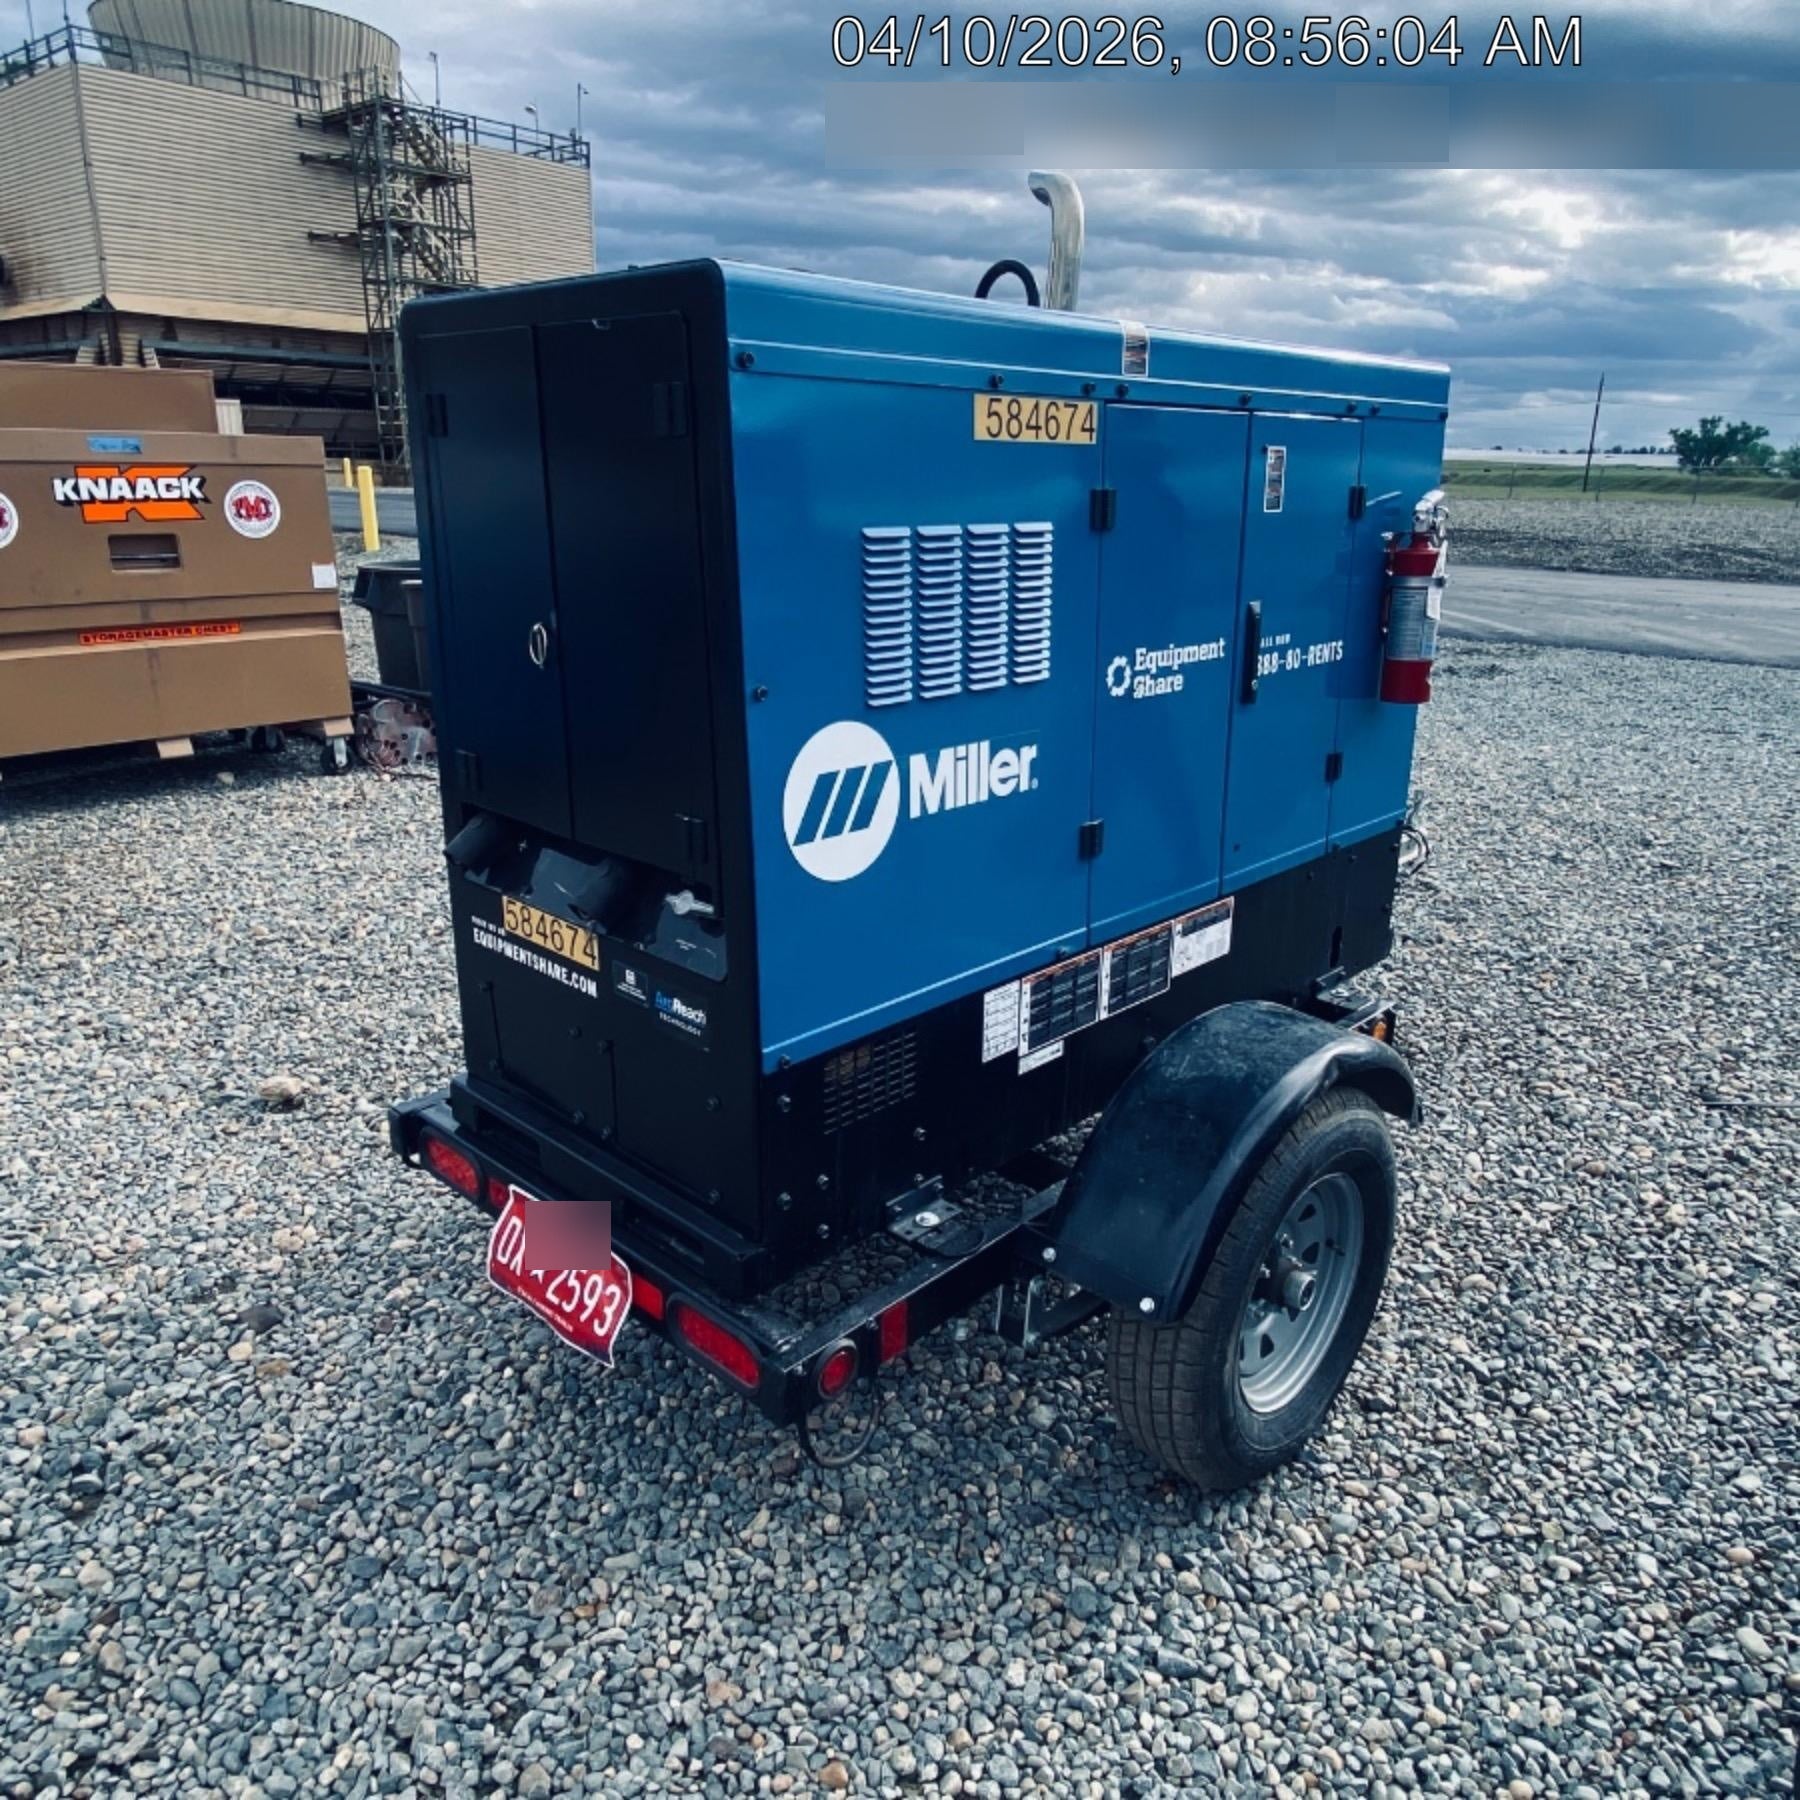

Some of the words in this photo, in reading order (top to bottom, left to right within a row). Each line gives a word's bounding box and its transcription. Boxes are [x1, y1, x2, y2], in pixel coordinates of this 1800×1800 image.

[986, 398, 1096, 442] 584674
[53, 477, 206, 503] KNAACK
[1135, 637, 1225, 673] Equipment
[1133, 673, 1183, 698] Share
[505, 899, 597, 967] 584674
[473, 927, 598, 998] EQUIPMENTSHARE.COM
